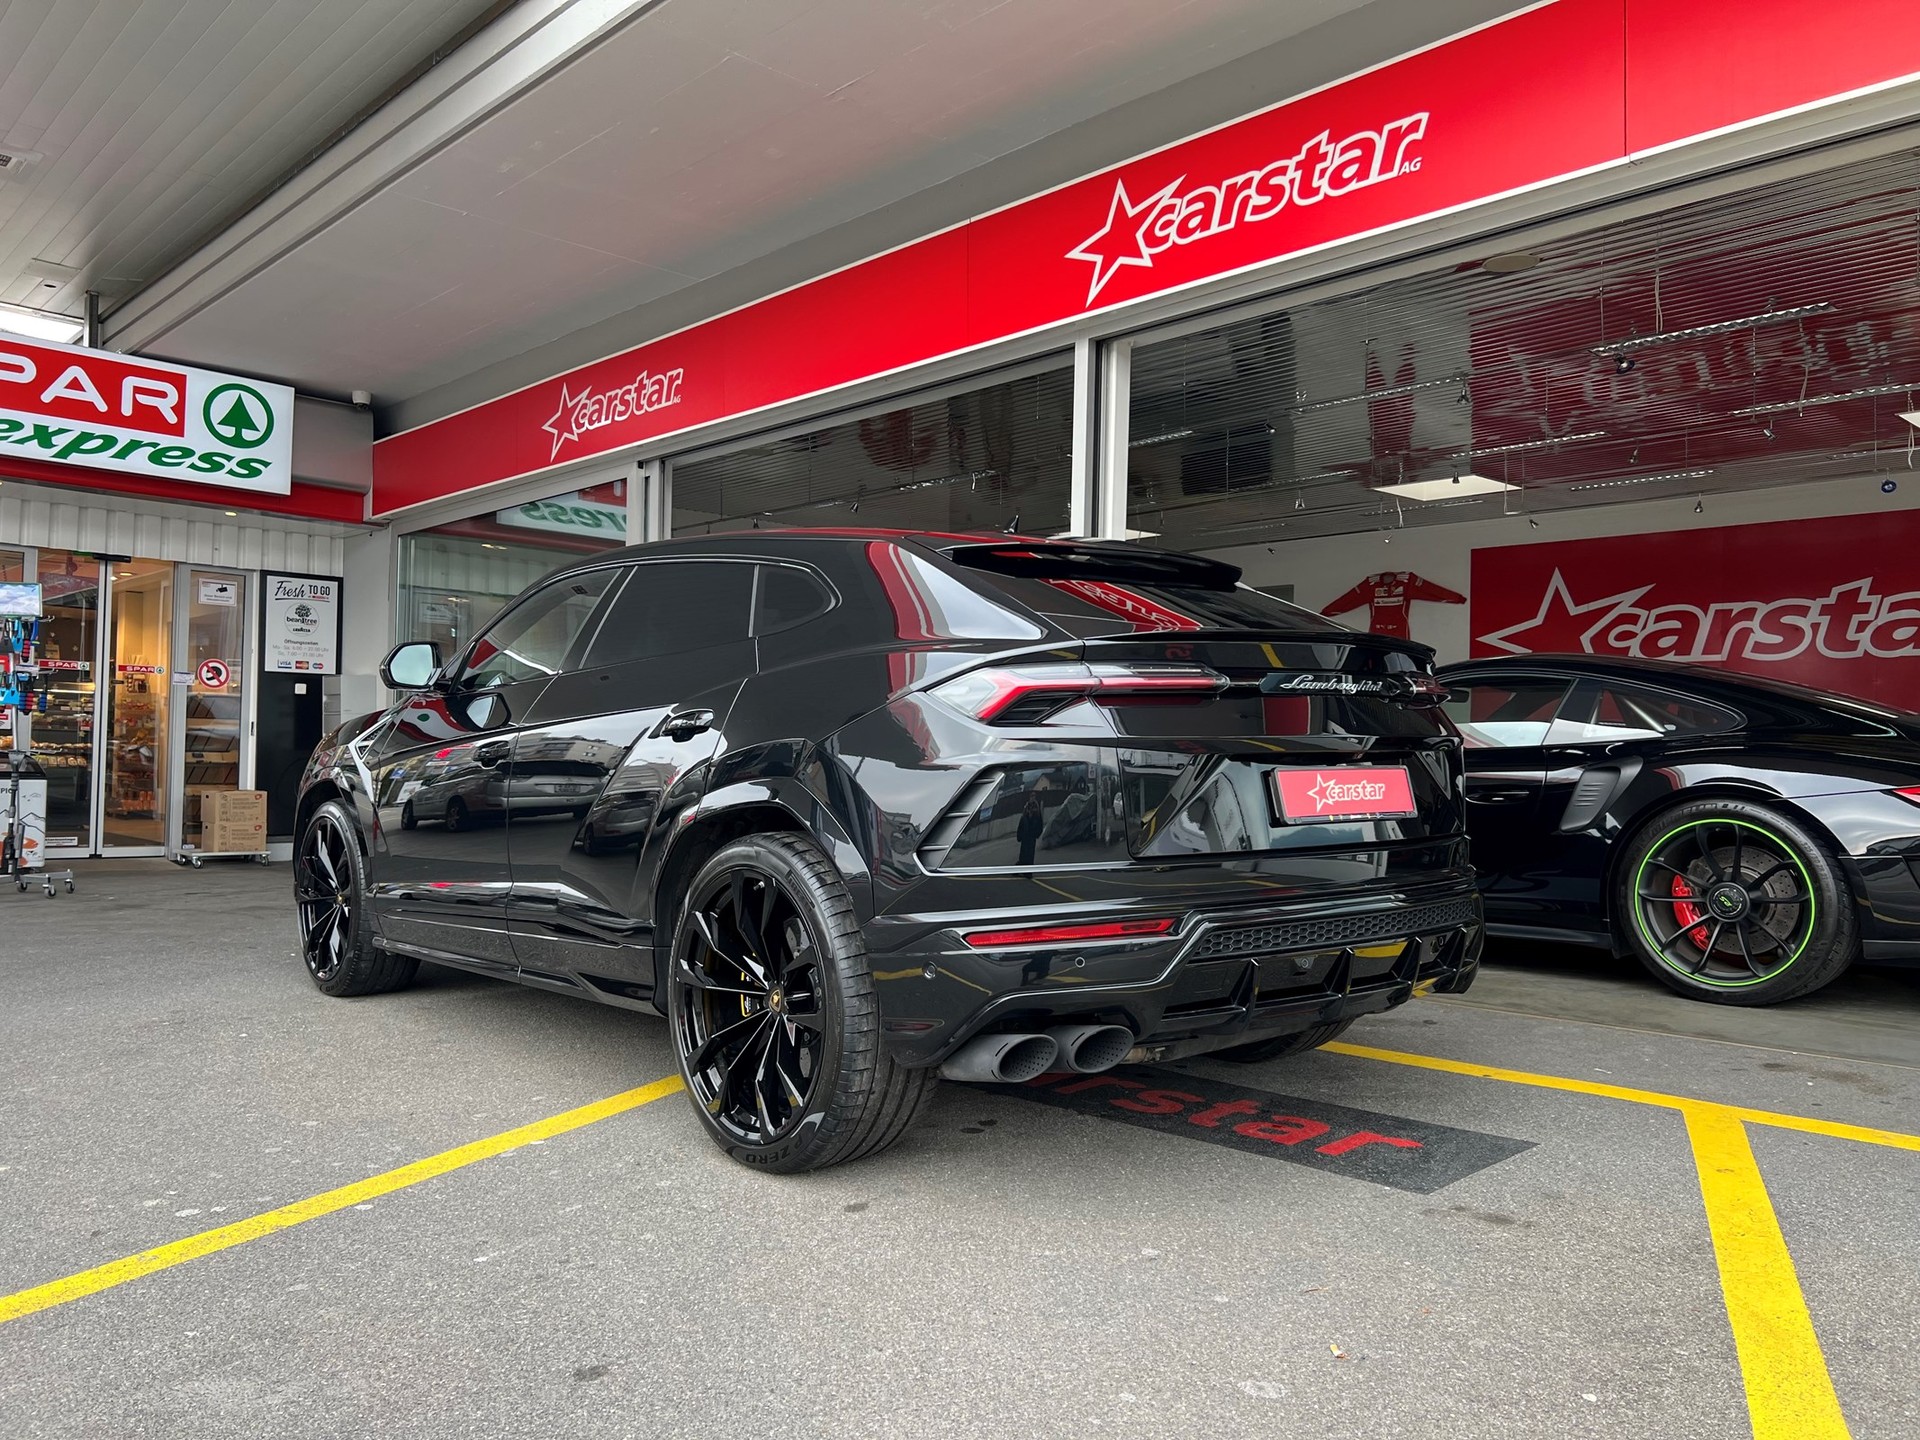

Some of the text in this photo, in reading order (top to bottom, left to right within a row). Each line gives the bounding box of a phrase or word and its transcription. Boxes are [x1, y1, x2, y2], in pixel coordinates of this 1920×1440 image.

[1136, 112, 1430, 254] carstar AG
[571, 368, 684, 434] carstar AG
[0, 418, 273, 479] express
[274, 580, 307, 598] Fresh
[308, 585, 318, 594] TO
[320, 586, 330, 596] GO
[48, 661, 79, 669] SPAR
[126, 665, 155, 673] SPAR
[1279, 674, 1384, 694] Lamborghini
[1327, 780, 1386, 801] carstar
[1026, 1072, 1425, 1156] rstar
[745, 1149, 792, 1164] ZERO
